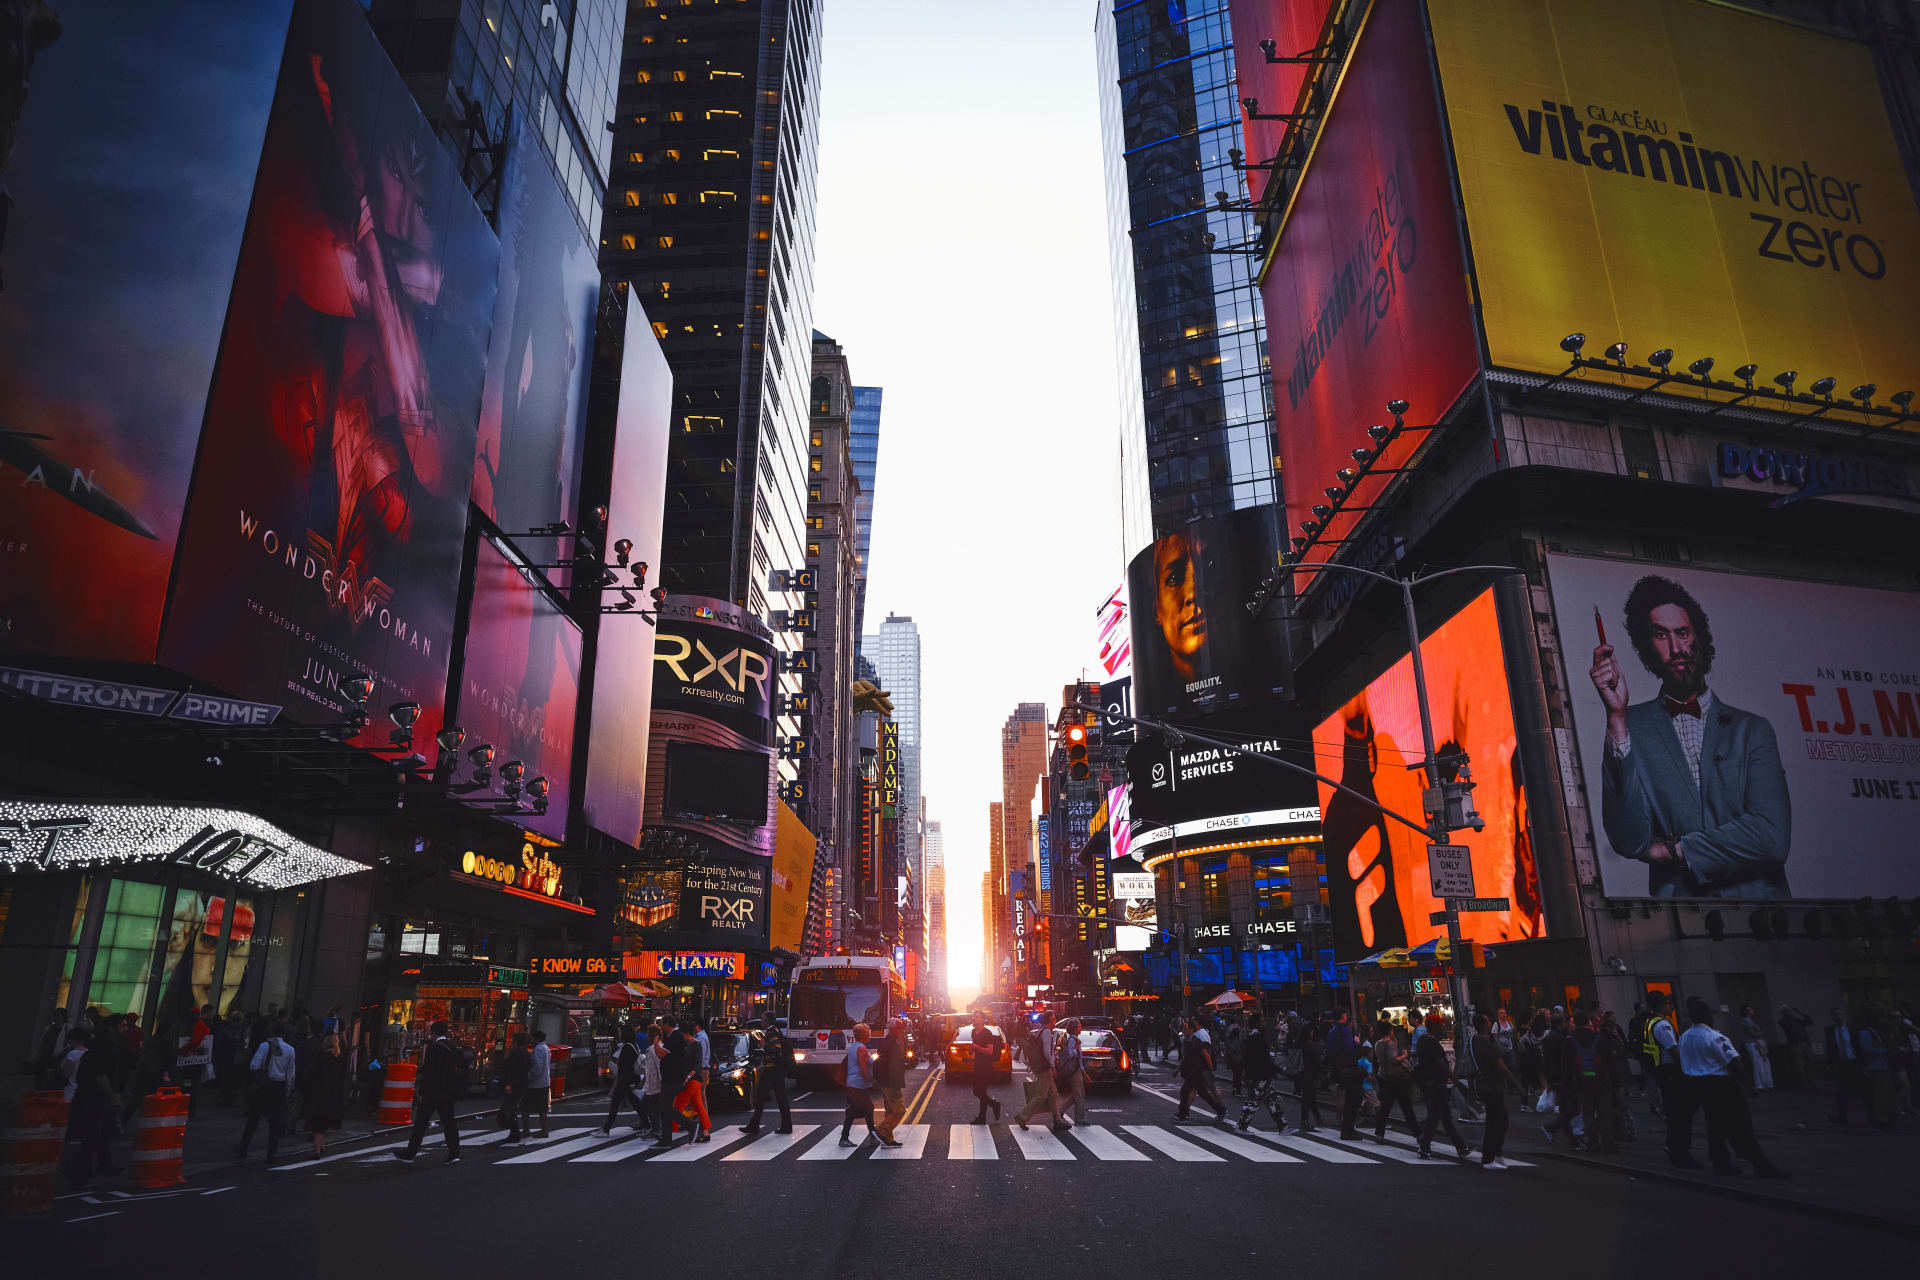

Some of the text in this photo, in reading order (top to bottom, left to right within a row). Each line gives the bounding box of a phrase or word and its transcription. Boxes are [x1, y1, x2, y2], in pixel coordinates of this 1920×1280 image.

[1586, 105, 1667, 136] GLACÉAU
[1503, 99, 1863, 225] vitaminwater
[1750, 212, 1887, 281] zero
[1360, 216, 1416, 348] zero
[240, 509, 431, 657] WONDER WOMAN
[247, 598, 264, 614] THE
[268, 611, 300, 635] FUTURE
[305, 631, 316, 642] OF
[320, 641, 349, 663] JUSTICE
[302, 657, 339, 692] JUN
[654, 633, 768, 702] RXR
[1817, 667, 1920, 687] AN HBO COME
[794, 573, 811, 798] CHAMPS
[1185, 675, 1222, 694] EQUALITY.
[681, 685, 745, 705] rxrrealty.com
[184, 698, 269, 725] PRIME
[471, 679, 569, 757] WONDER WOMAN
[1781, 682, 1920, 739] T.J. M
[649, 721, 696, 731] SHARP
[883, 722, 898, 803] MADAME
[1181, 750, 1220, 767] MAZDA
[1181, 760, 1235, 780] SERVICES
[1851, 778, 1904, 800] JUNE
[1206, 817, 1240, 829] CHASE
[1289, 810, 1321, 820] CHAS
[1040, 832, 1049, 849] 42
[1151, 829, 1172, 840] CHASE
[176, 824, 286, 880] LOFT
[1436, 849, 1462, 859] BUSES
[729, 866, 747, 878] New
[748, 868, 761, 880] York
[1041, 859, 1050, 890] STUDIOS
[1440, 860, 1460, 870] ONLY
[685, 877, 763, 898] for the 21st Century
[1095, 857, 1106, 901] VICTORY
[700, 895, 754, 922] RXR
[1469, 900, 1508, 910] Broadway
[712, 919, 747, 929] REALTY
[1015, 899, 1025, 962] REGAL
[1194, 925, 1231, 938] CHASE
[1247, 921, 1297, 935] CHASE
[543, 958, 582, 973] KNOW
[658, 955, 736, 975] CHAMPS
[1110, 989, 1134, 997] ubwy
[1414, 980, 1440, 993] SODA
